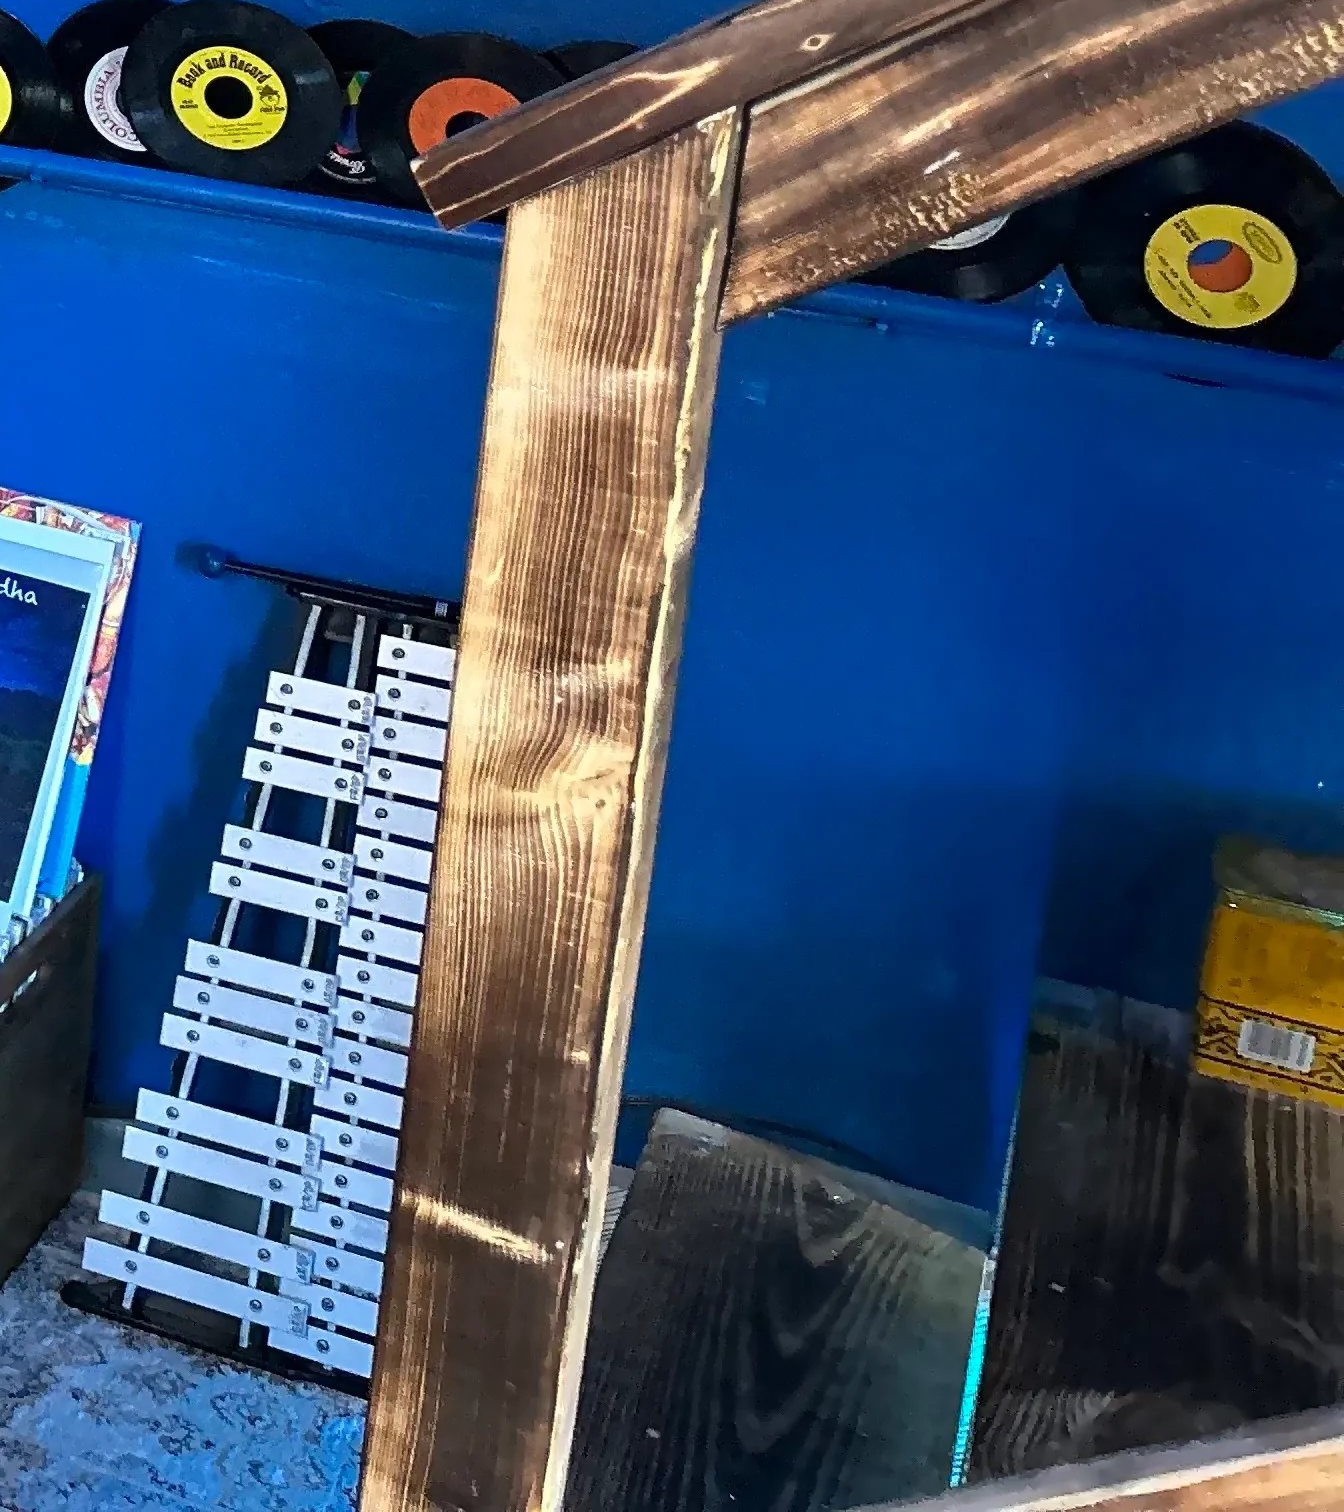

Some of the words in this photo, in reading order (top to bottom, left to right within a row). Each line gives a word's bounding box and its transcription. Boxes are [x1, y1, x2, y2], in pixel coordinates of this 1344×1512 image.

[204, 52, 227, 69] and
[229, 53, 273, 84] Record
[95, 69, 138, 142] COLUMBIA
